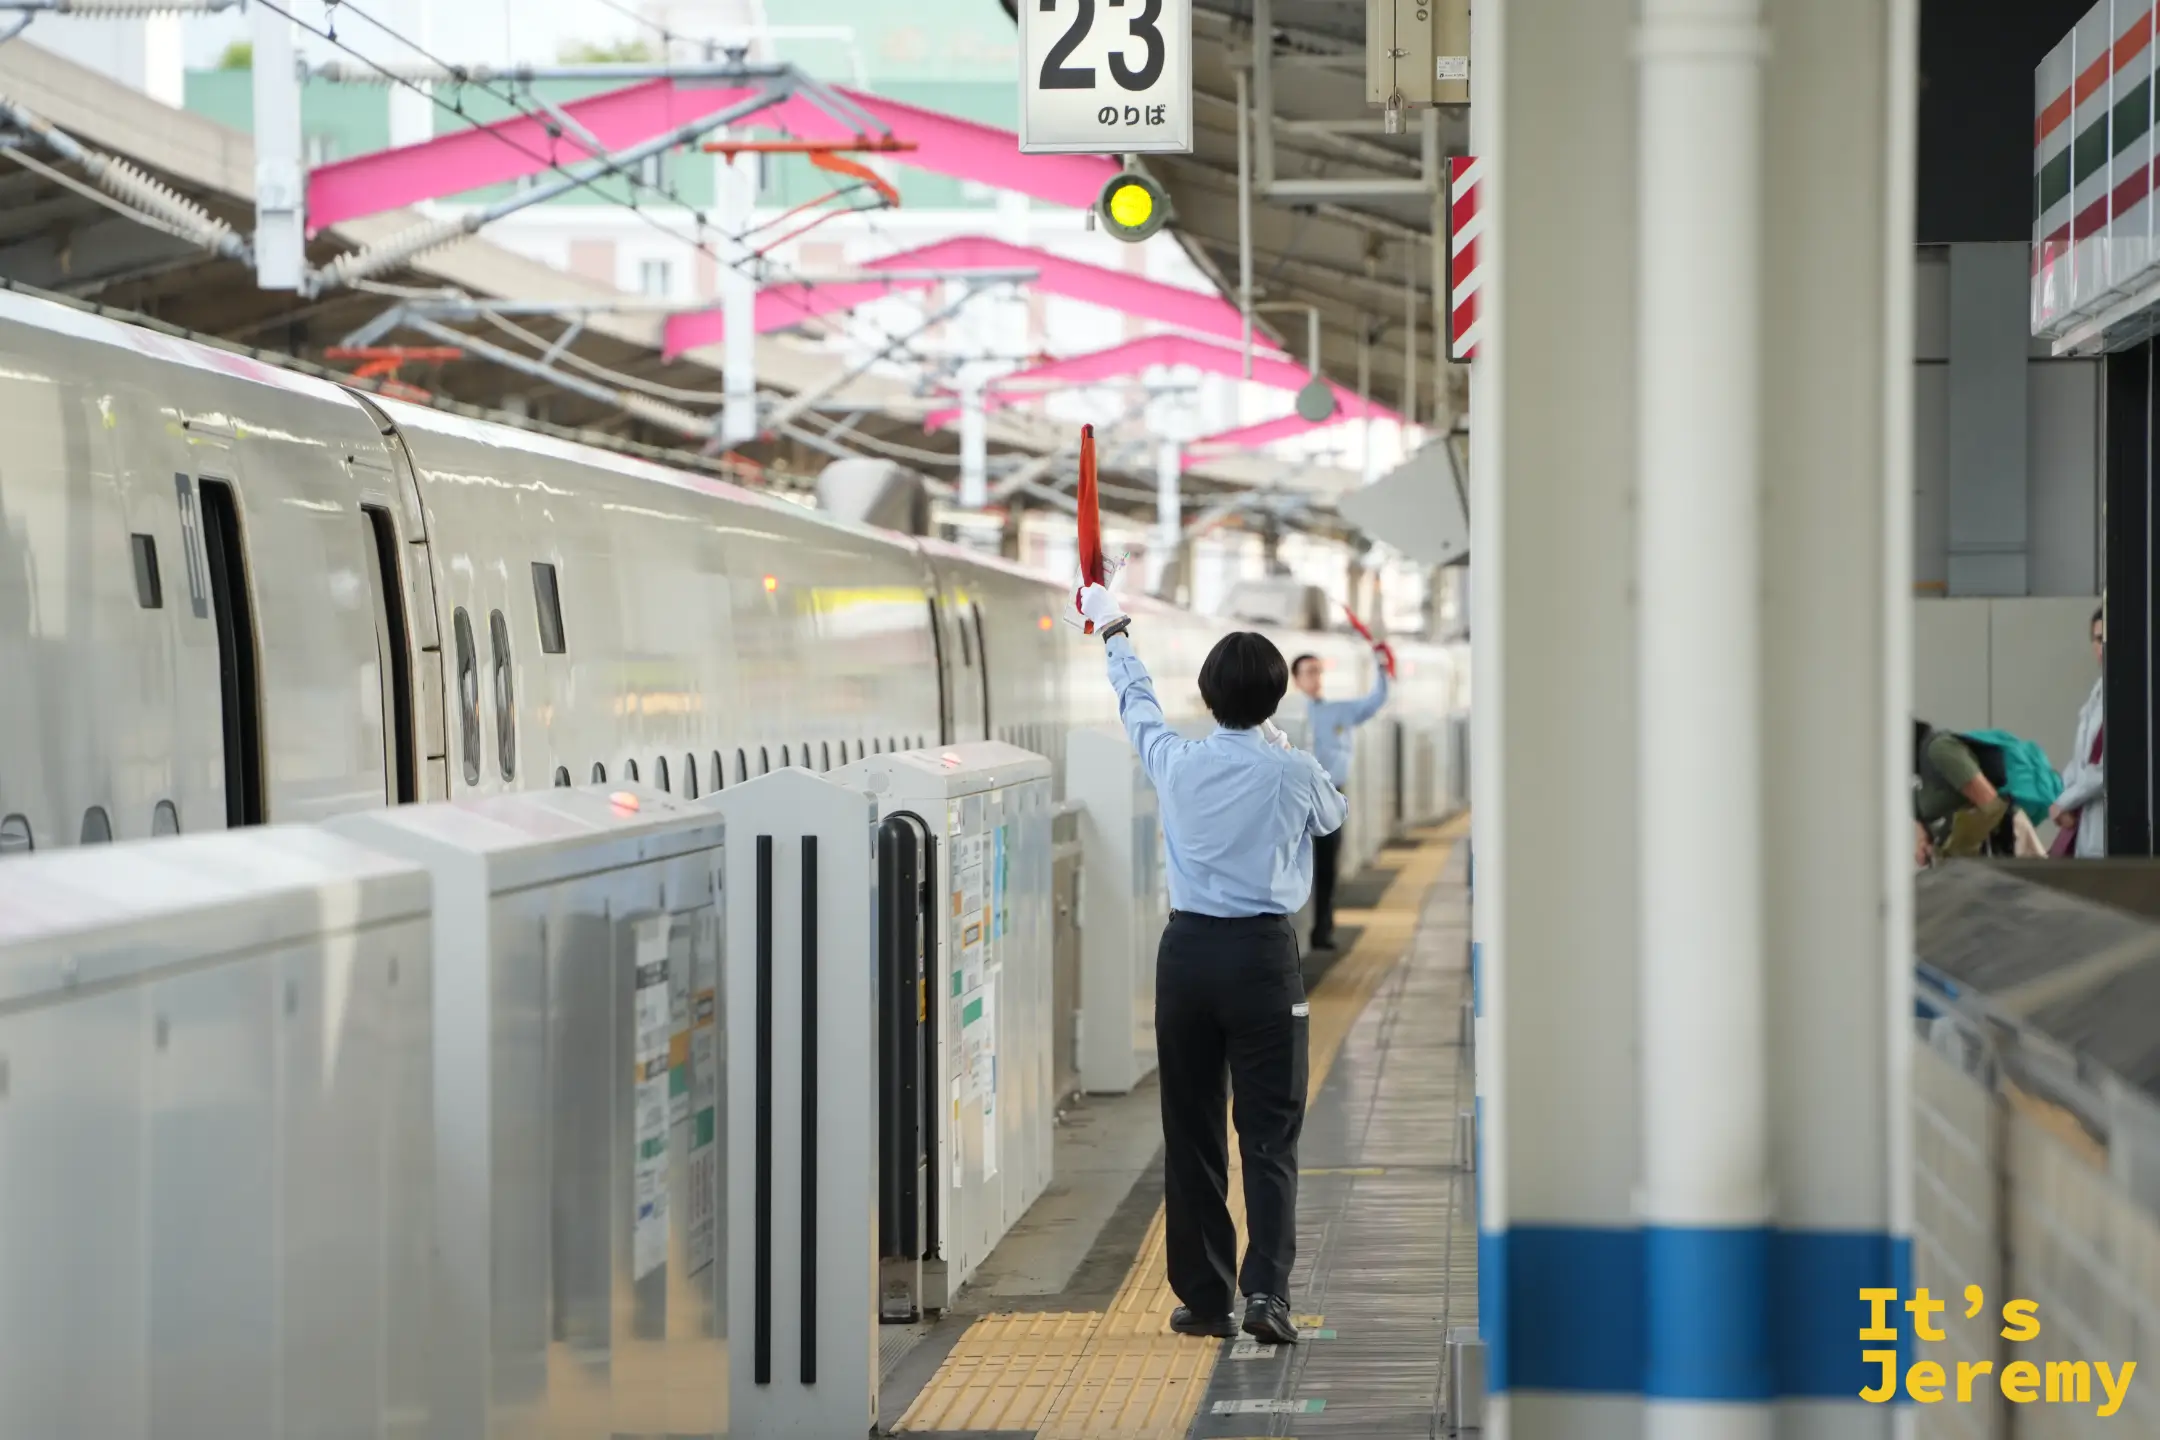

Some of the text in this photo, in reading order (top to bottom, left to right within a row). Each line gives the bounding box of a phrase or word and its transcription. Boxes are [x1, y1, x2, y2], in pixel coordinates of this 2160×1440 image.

[1039, 0, 1165, 92] 23
[1097, 104, 1166, 126] のりば
